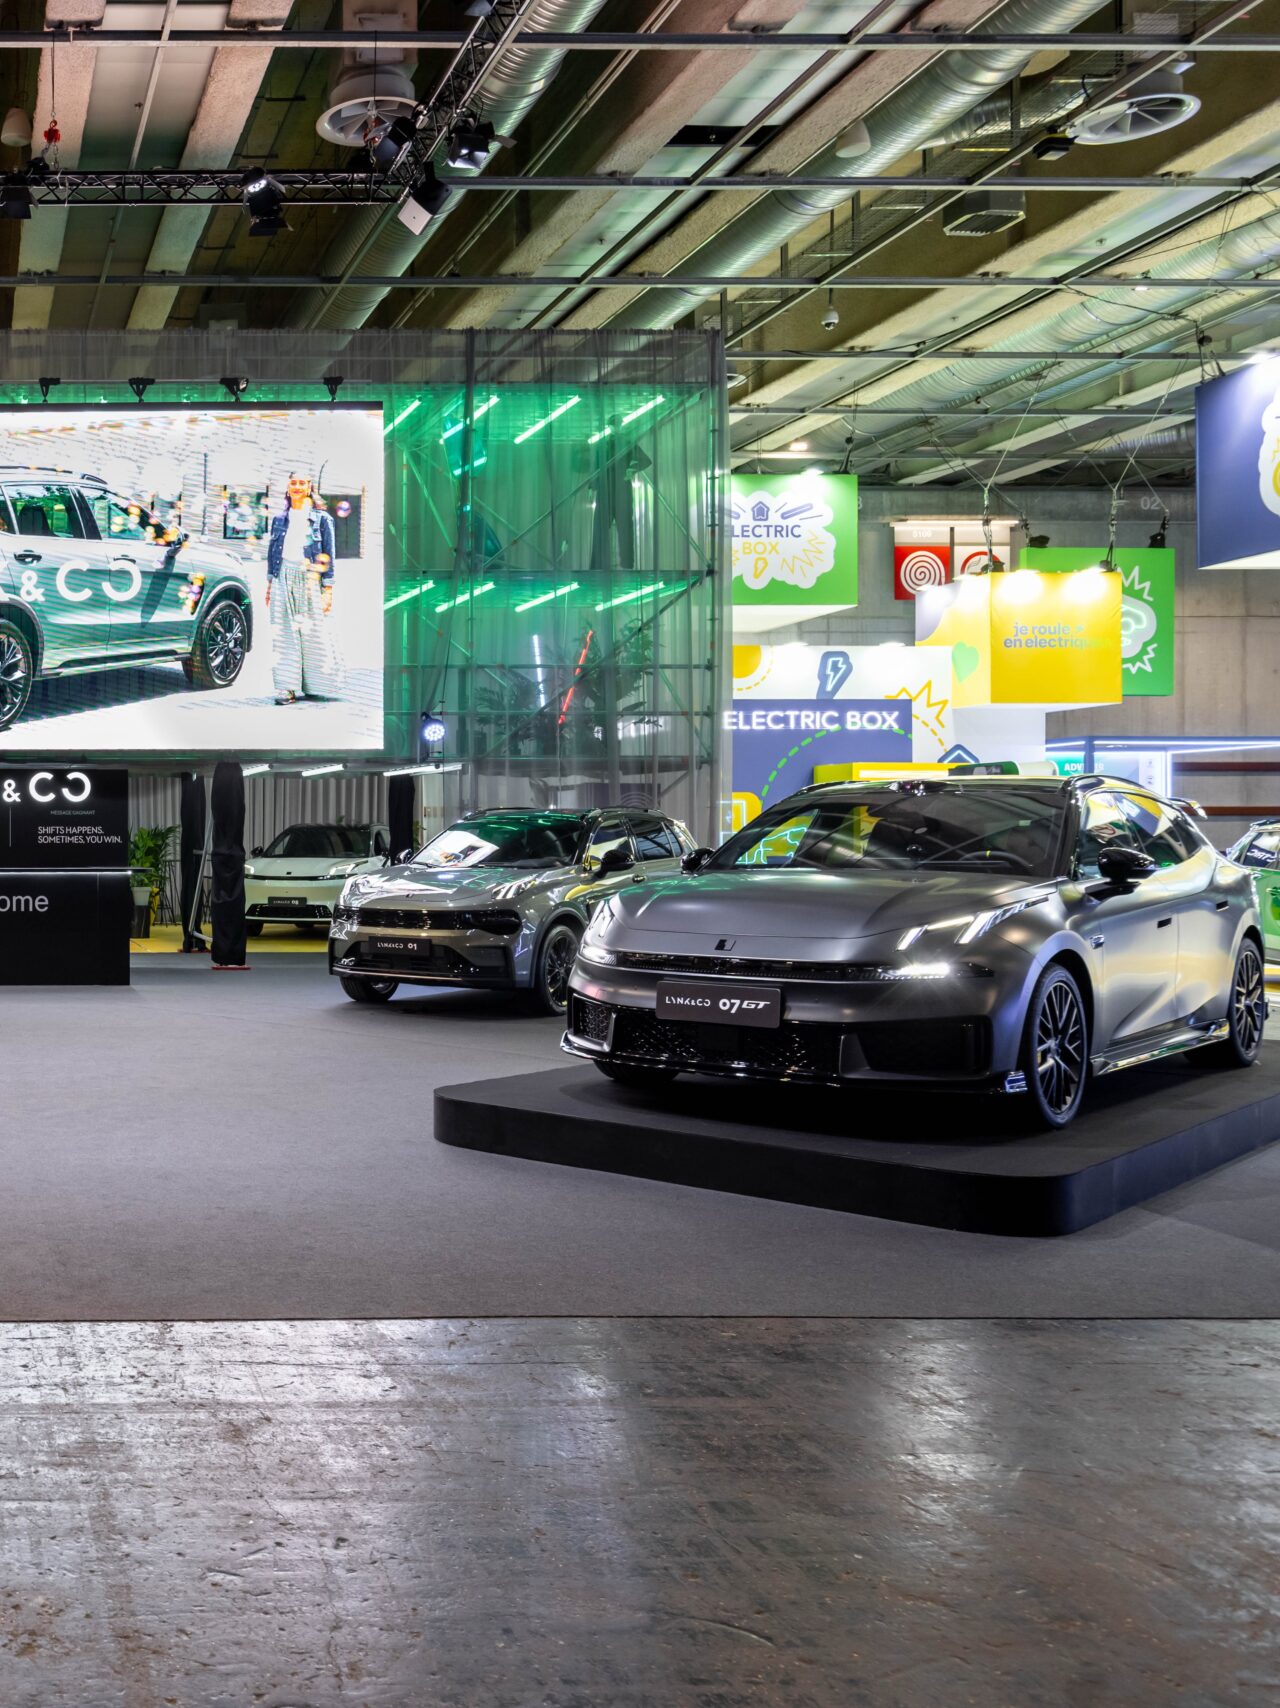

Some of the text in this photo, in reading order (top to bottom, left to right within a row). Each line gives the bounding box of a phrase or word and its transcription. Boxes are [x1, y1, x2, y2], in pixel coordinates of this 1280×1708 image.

[1140, 496, 1160, 510] 02
[742, 541, 780, 555] BOX
[1013, 622, 1071, 637] je roule
[1003, 637, 1022, 648] en
[722, 710, 900, 730] ELECTRIC BOX
[38, 826, 104, 834] SHIFTS HAPPENS.
[85, 835, 103, 844] YOU
[103, 835, 123, 844] WIN.
[665, 996, 711, 1007] LYNK&CO
